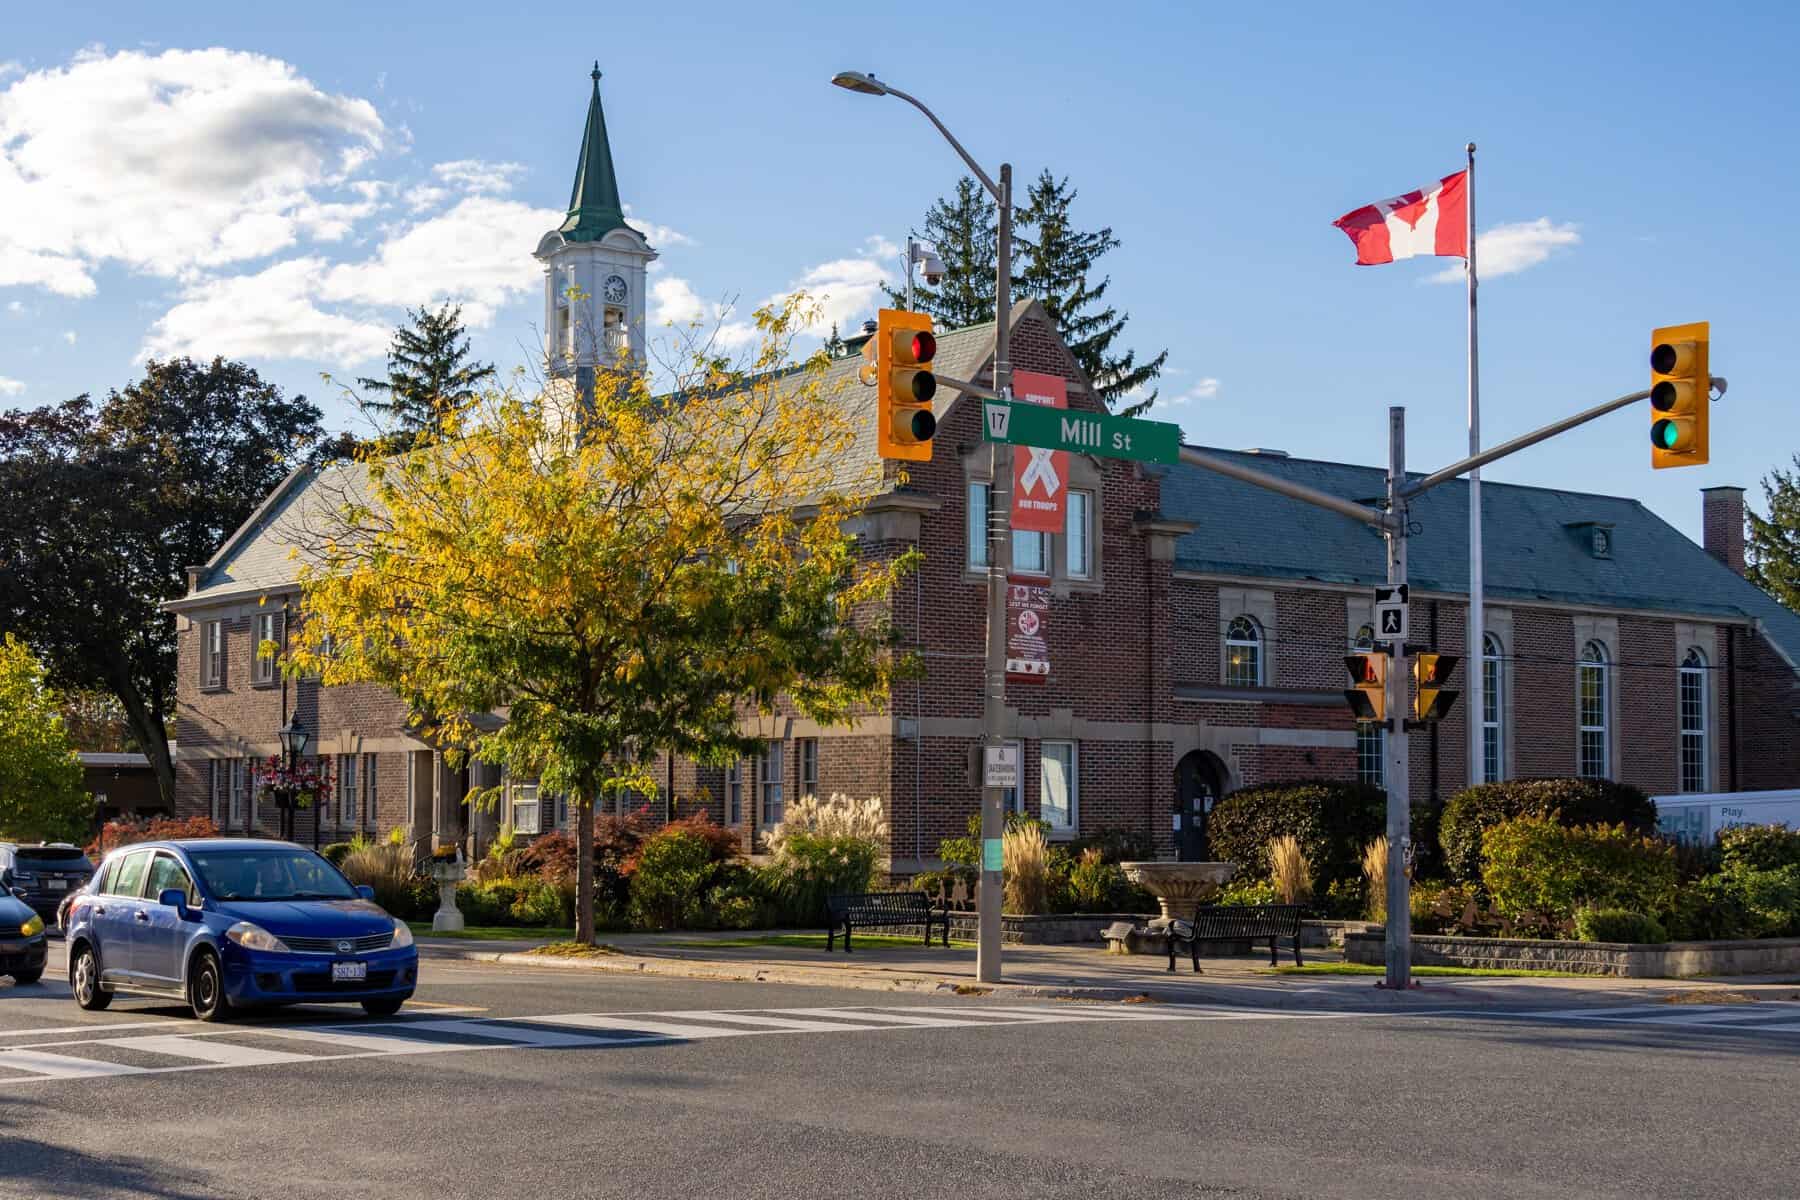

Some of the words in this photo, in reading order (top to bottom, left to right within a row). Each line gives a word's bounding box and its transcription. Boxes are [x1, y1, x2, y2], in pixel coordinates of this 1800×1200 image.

[1025, 393, 1056, 406] SUPPORT
[991, 412, 1005, 430] 17
[1061, 417, 1102, 447] Mill
[1112, 431, 1131, 451] St
[1018, 499, 1032, 509] OUR
[1033, 500, 1057, 511] TROOPS
[1721, 807, 1744, 818] Play
